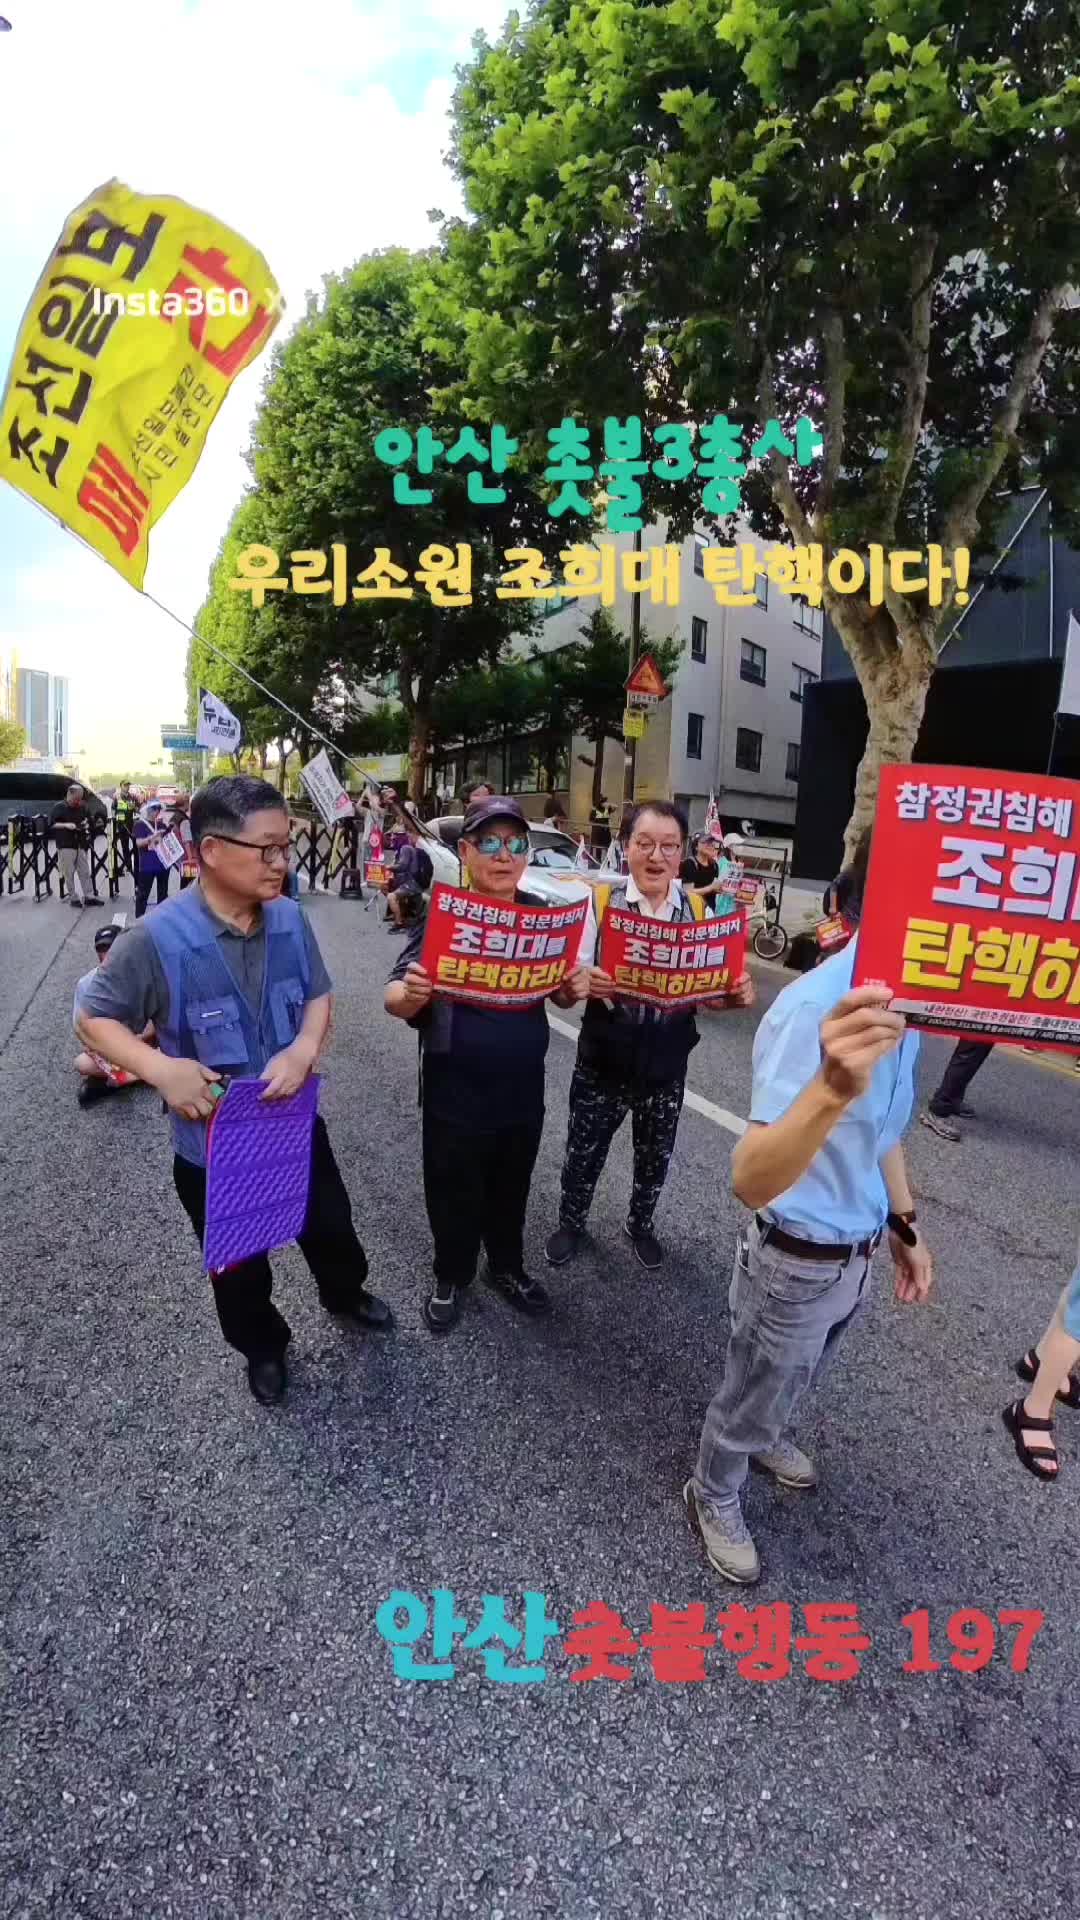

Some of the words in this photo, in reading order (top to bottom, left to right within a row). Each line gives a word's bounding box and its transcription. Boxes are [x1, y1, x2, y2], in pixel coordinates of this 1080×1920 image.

[8, 208, 167, 488] 조선일보
[895, 781, 1073, 838] 참정권침해
[931, 836, 1080, 921] 조희
[437, 892, 517, 928] 참정권침해
[520, 905, 585, 930] 전문범죄자
[609, 913, 678, 943] 참정권침해
[681, 917, 741, 943] 전문범죄자
[449, 922, 567, 960] 조희대를
[623, 937, 726, 969] 조희대를
[437, 955, 567, 990] 탄핵하라!
[614, 965, 730, 995] 탄핵하라!
